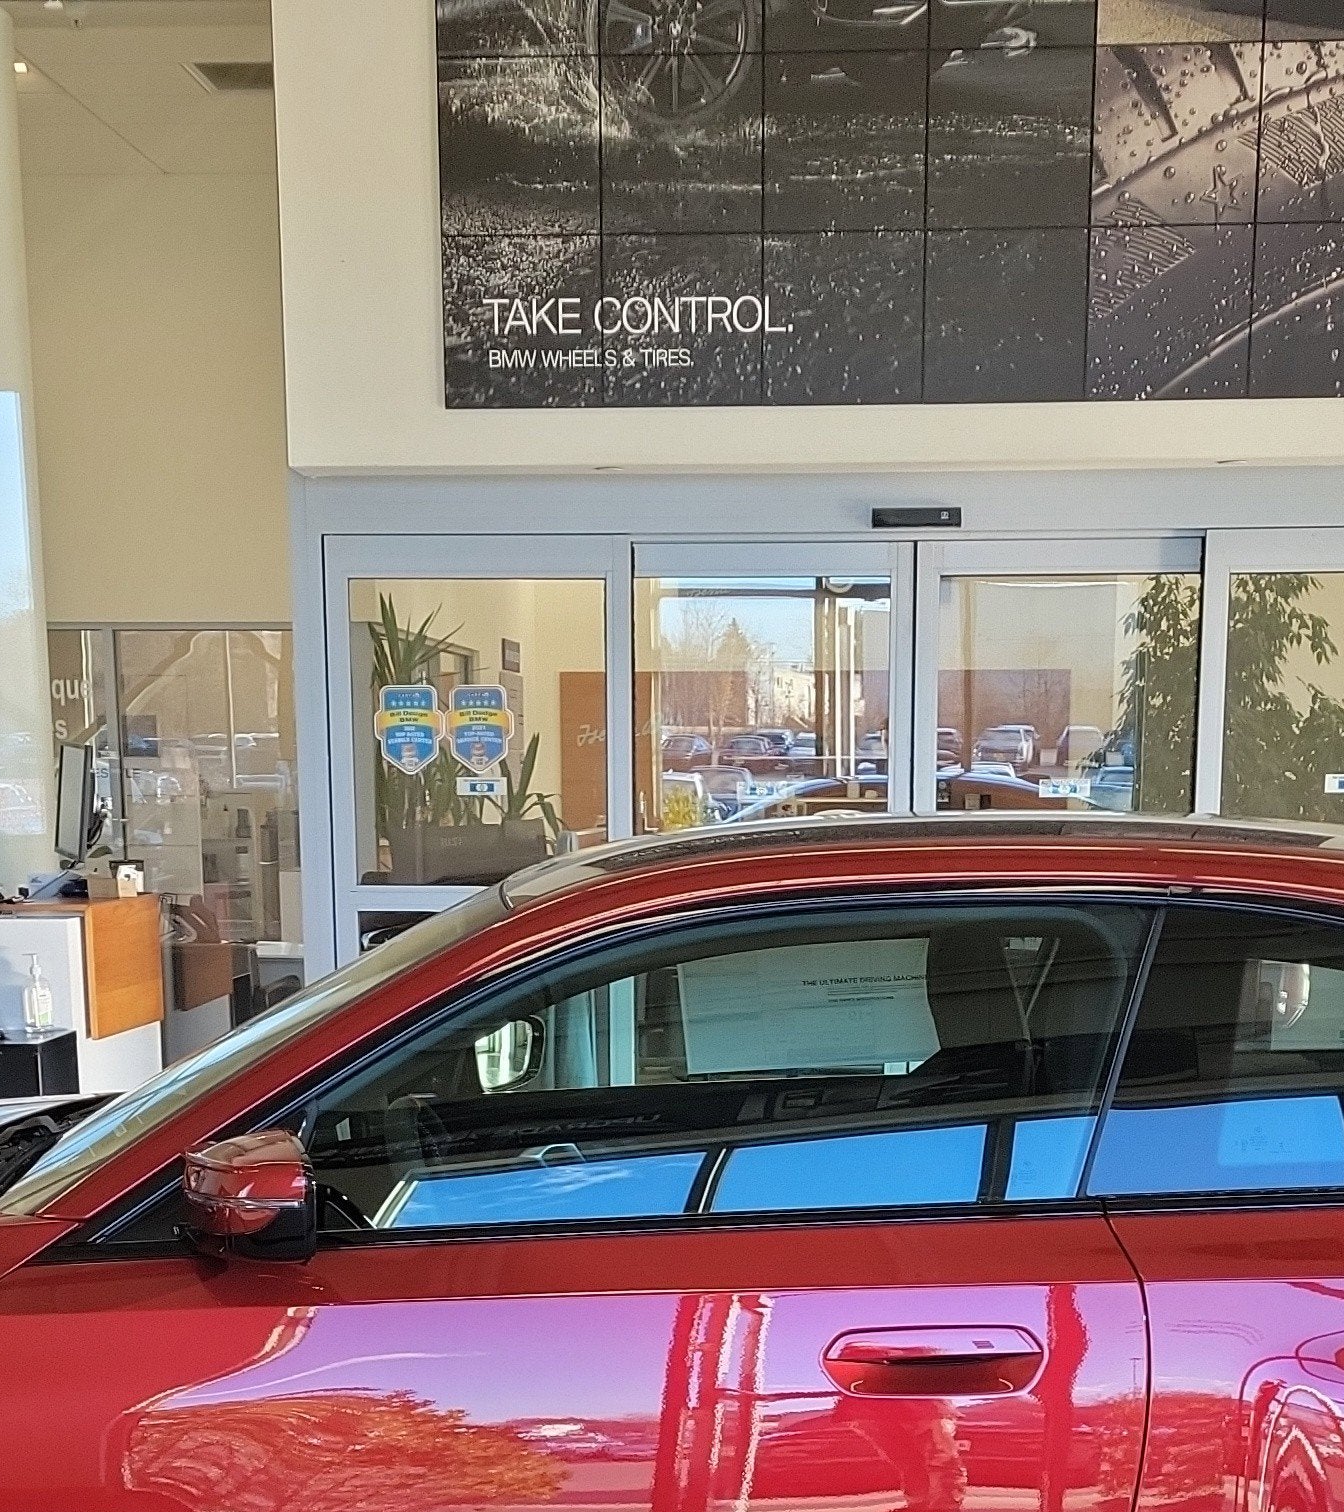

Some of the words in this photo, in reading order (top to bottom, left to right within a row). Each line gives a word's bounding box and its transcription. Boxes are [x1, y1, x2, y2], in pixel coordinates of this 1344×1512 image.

[482, 297, 583, 335] TAKE
[594, 295, 794, 335] CONTROL.
[488, 349, 536, 368] BMW
[541, 349, 617, 368] WHEELS
[622, 349, 637, 367] &
[641, 348, 694, 368] TIRES.
[819, 977, 858, 986] ULTIMATE
